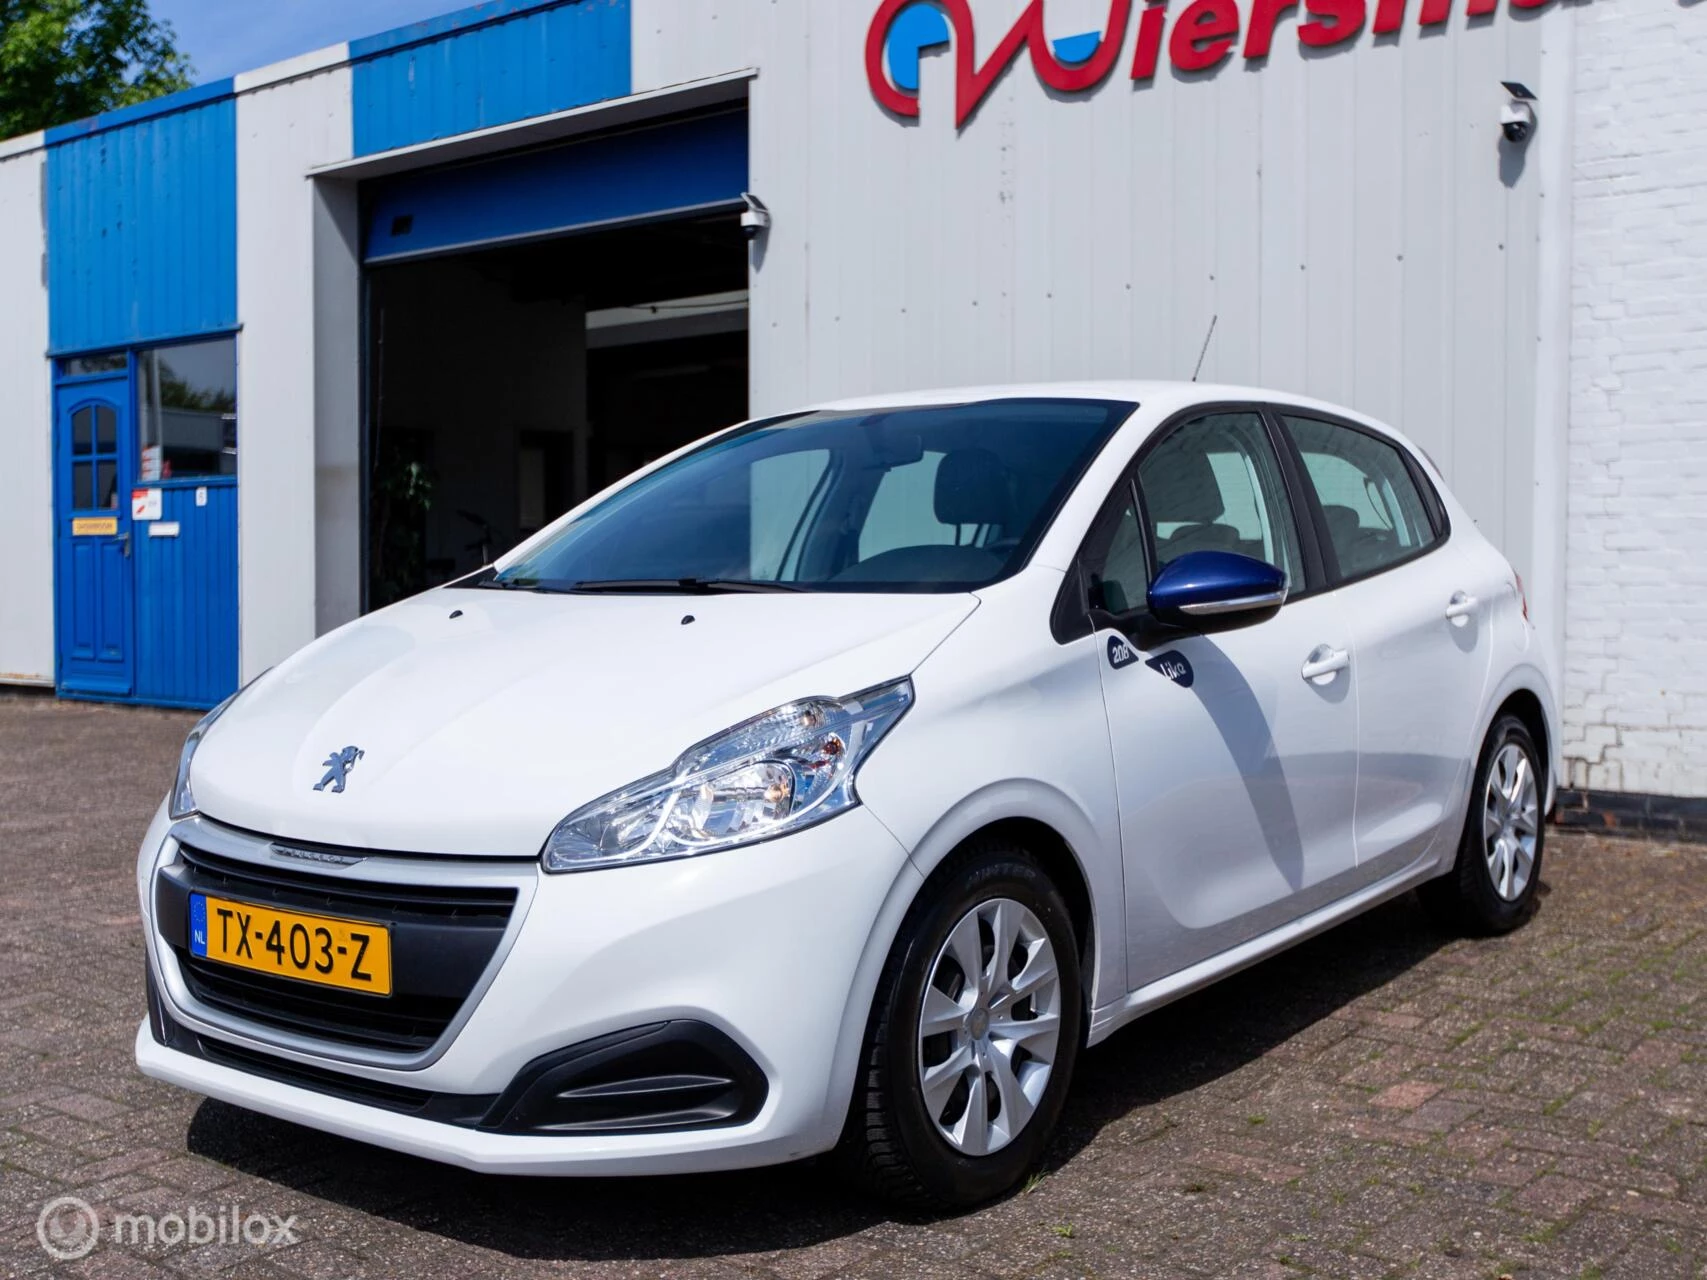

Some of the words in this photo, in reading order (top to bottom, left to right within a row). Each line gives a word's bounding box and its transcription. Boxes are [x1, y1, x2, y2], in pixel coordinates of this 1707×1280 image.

[1112, 644, 1130, 664] 208
[194, 929, 206, 945] NL
[216, 907, 373, 982] TX-403-Z
